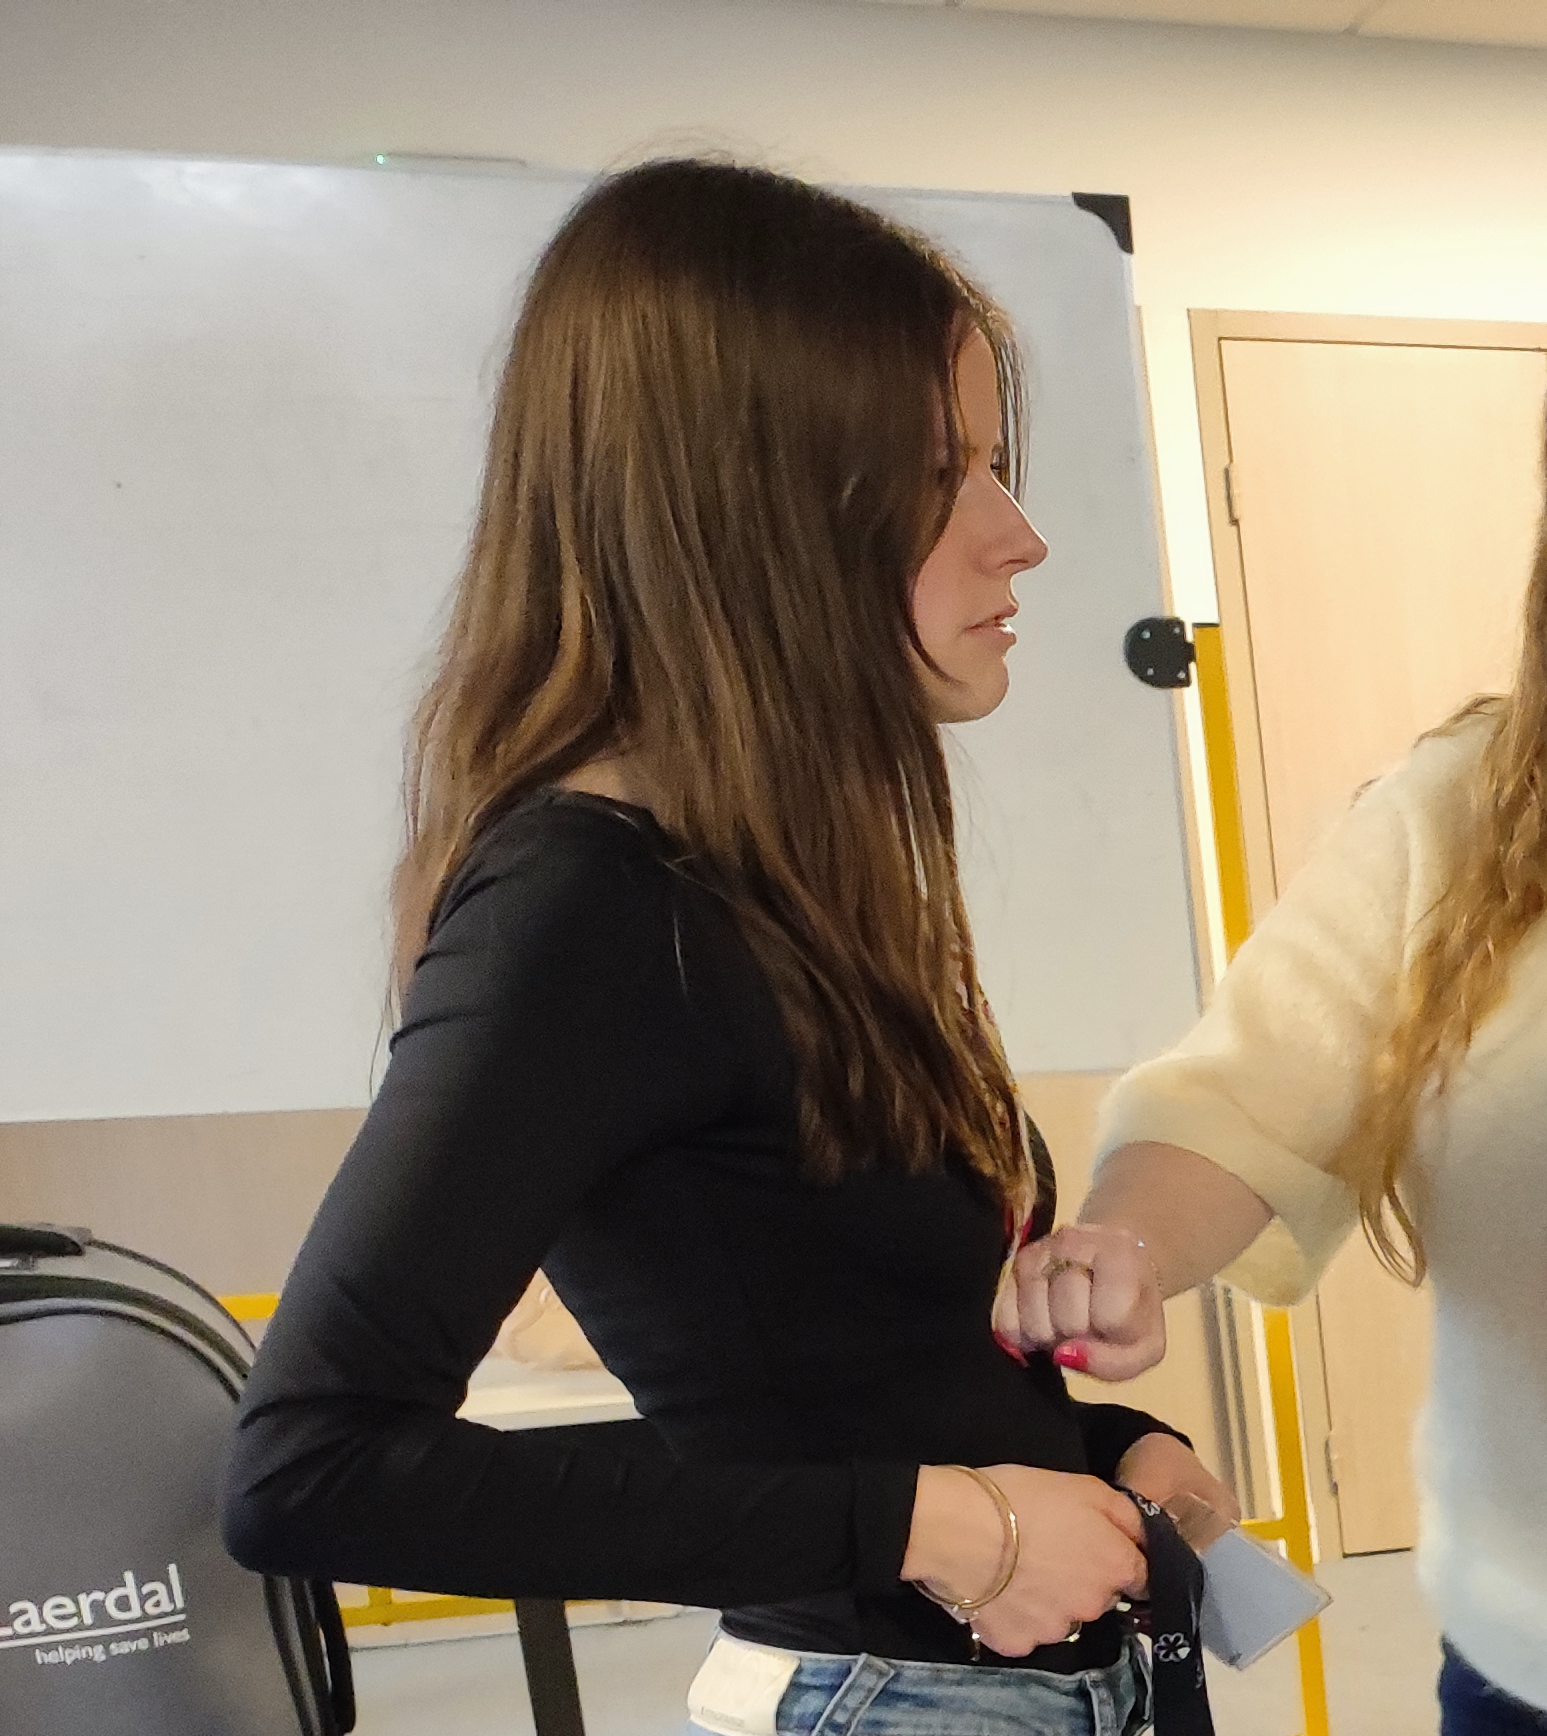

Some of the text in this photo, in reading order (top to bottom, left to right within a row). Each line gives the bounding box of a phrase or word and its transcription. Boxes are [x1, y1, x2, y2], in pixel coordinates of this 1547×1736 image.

[35, 1628, 191, 1665] helping save lives
